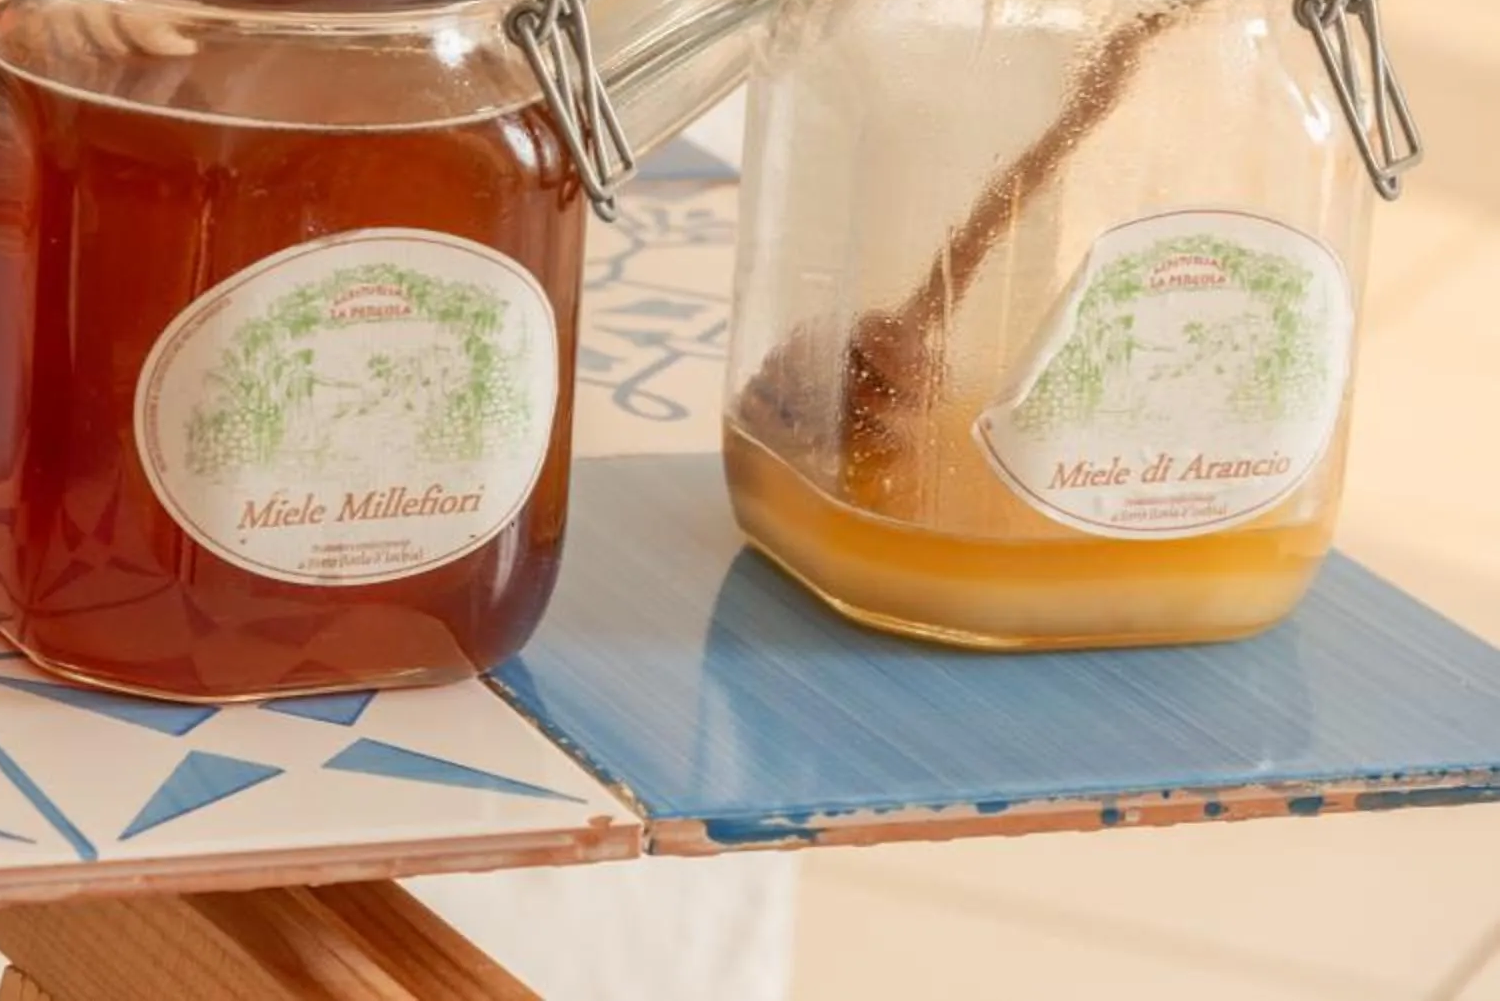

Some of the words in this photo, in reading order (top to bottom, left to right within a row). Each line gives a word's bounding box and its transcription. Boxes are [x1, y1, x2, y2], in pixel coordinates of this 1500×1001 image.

[1049, 456, 1131, 489] Miele
[1141, 452, 1174, 483] di
[1180, 451, 1292, 481] Arancio
[237, 493, 327, 529] Miele
[336, 483, 486, 522] Millefiori
